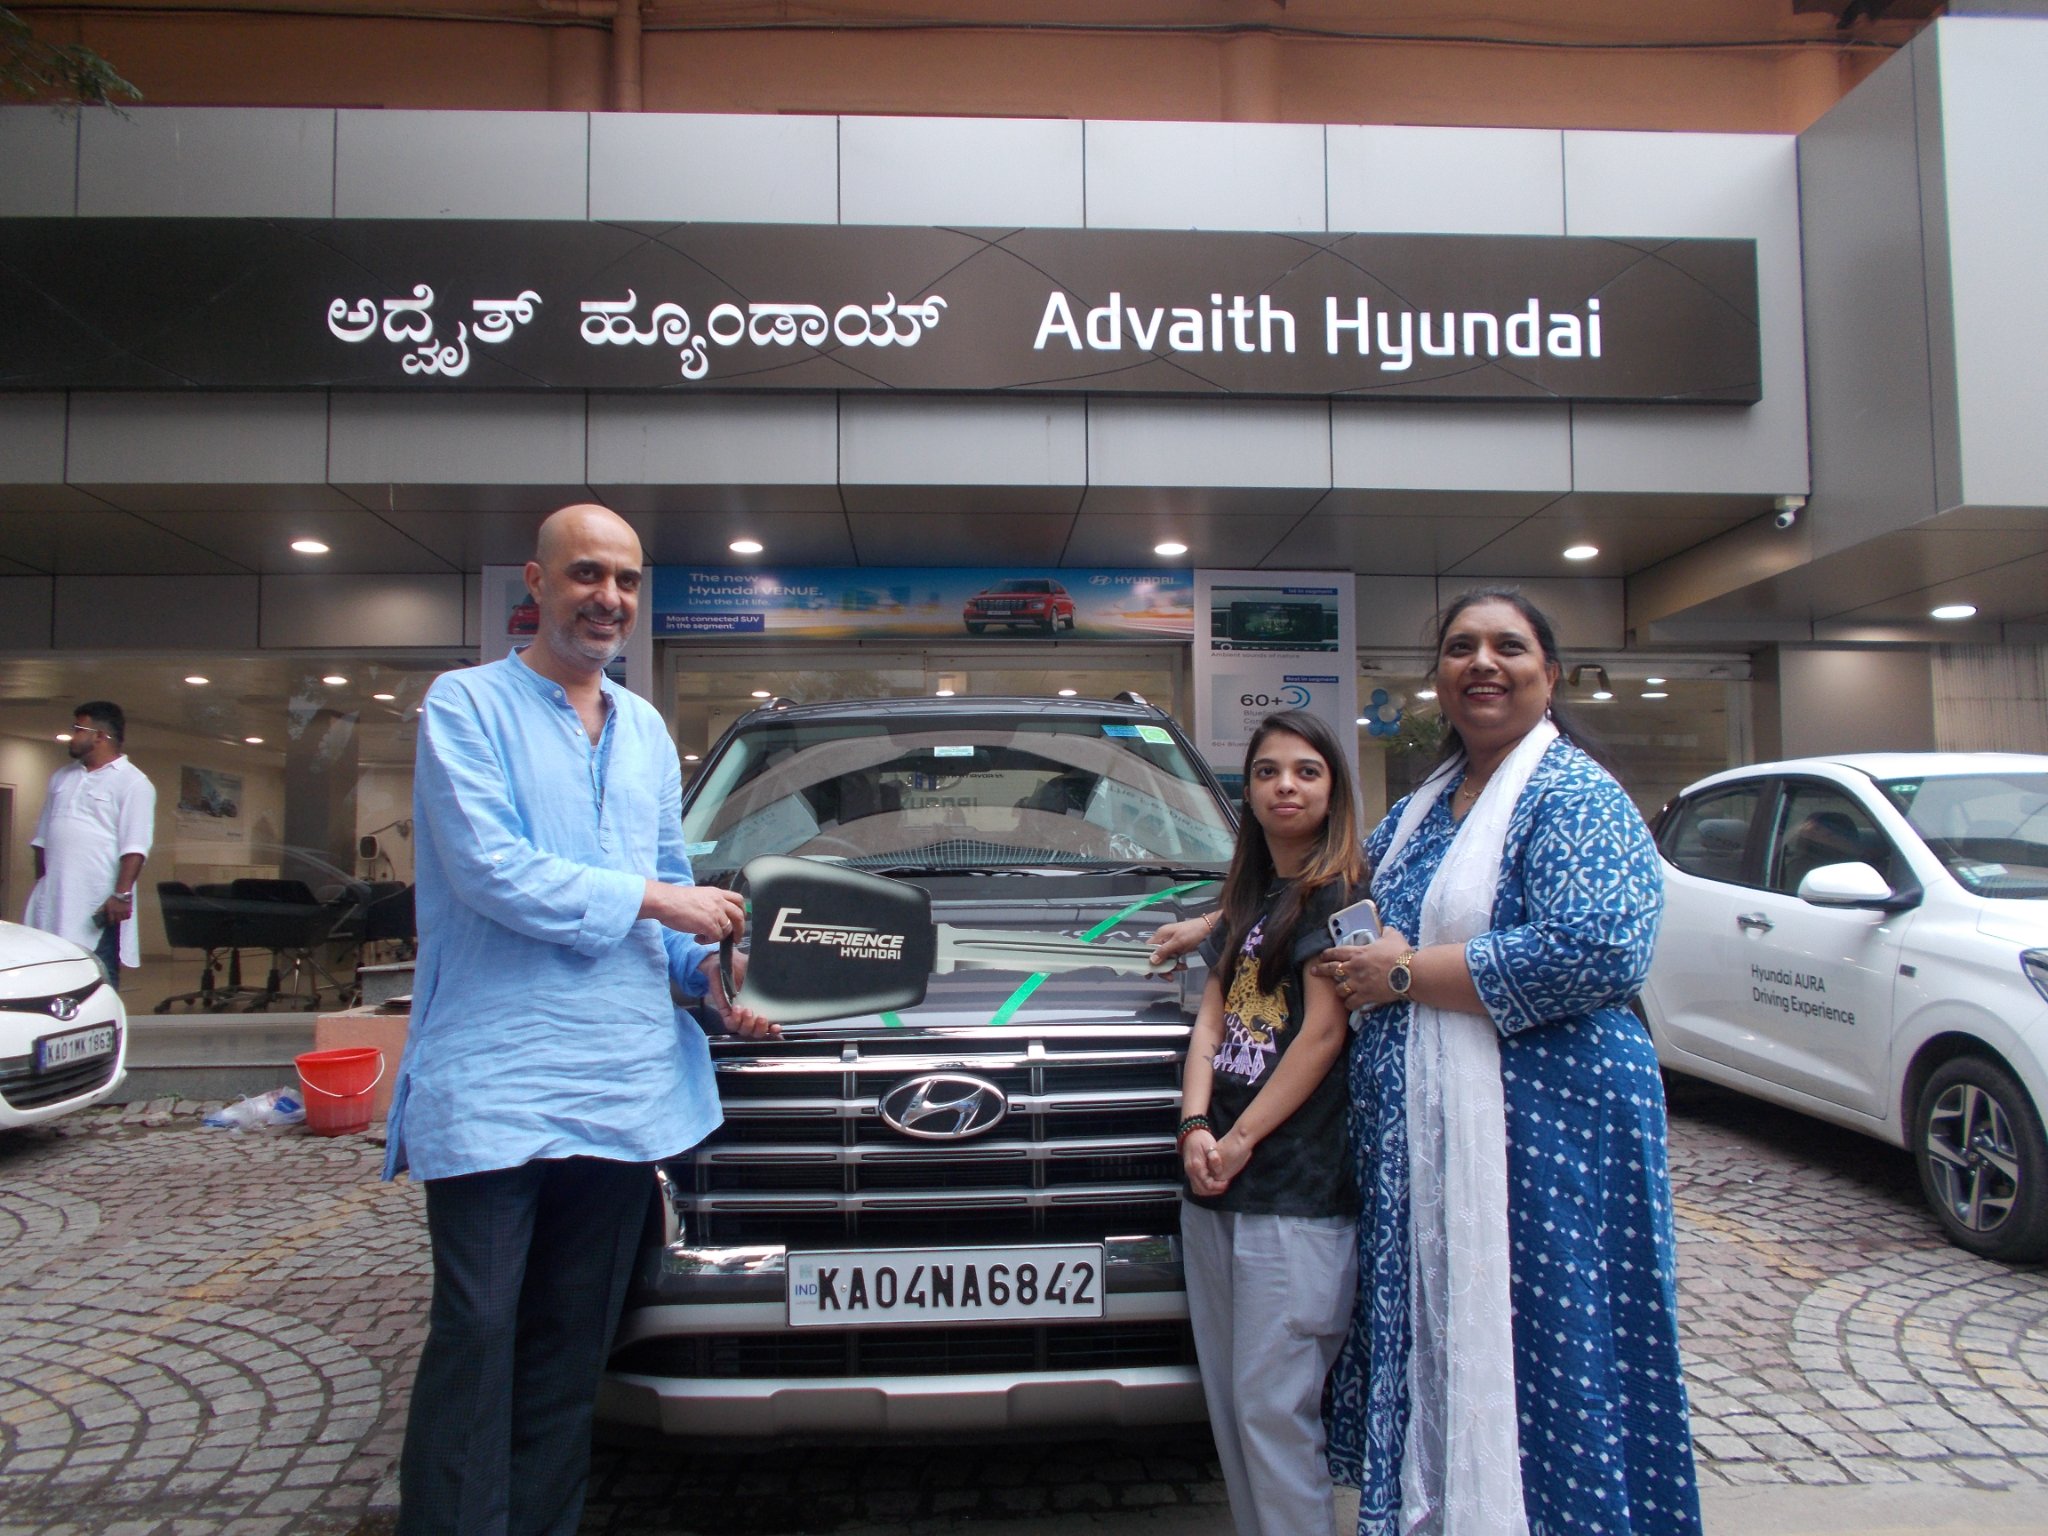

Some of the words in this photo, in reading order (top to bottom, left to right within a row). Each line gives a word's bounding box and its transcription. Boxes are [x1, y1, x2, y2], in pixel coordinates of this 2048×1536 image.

[326, 283, 543, 377] ಅದ್ವೈತ್
[580, 288, 949, 379] ಹ್ಯೂಂಡಾಯ್
[1033, 291, 1297, 353] Advaith
[1325, 296, 1602, 372] Hyundai
[689, 573, 720, 582] The
[1114, 576, 1175, 585] HYUNDAI
[689, 586, 758, 597] Hyundai
[761, 586, 823, 596] VENUE.
[688, 598, 712, 606] Live
[714, 598, 733, 606] the
[690, 615, 739, 623] connected
[1240, 694, 1283, 706] 60+
[768, 907, 905, 949] EXPERIENCE
[840, 946, 901, 960] HYUNDAI
[1751, 964, 1793, 986] Hyundai
[1794, 973, 1826, 993] AURA
[1752, 986, 1790, 1013] Driving
[1791, 995, 1855, 1026] Experience
[794, 1284, 818, 1297] IND
[818, 1261, 1095, 1311] KA04NA6842
